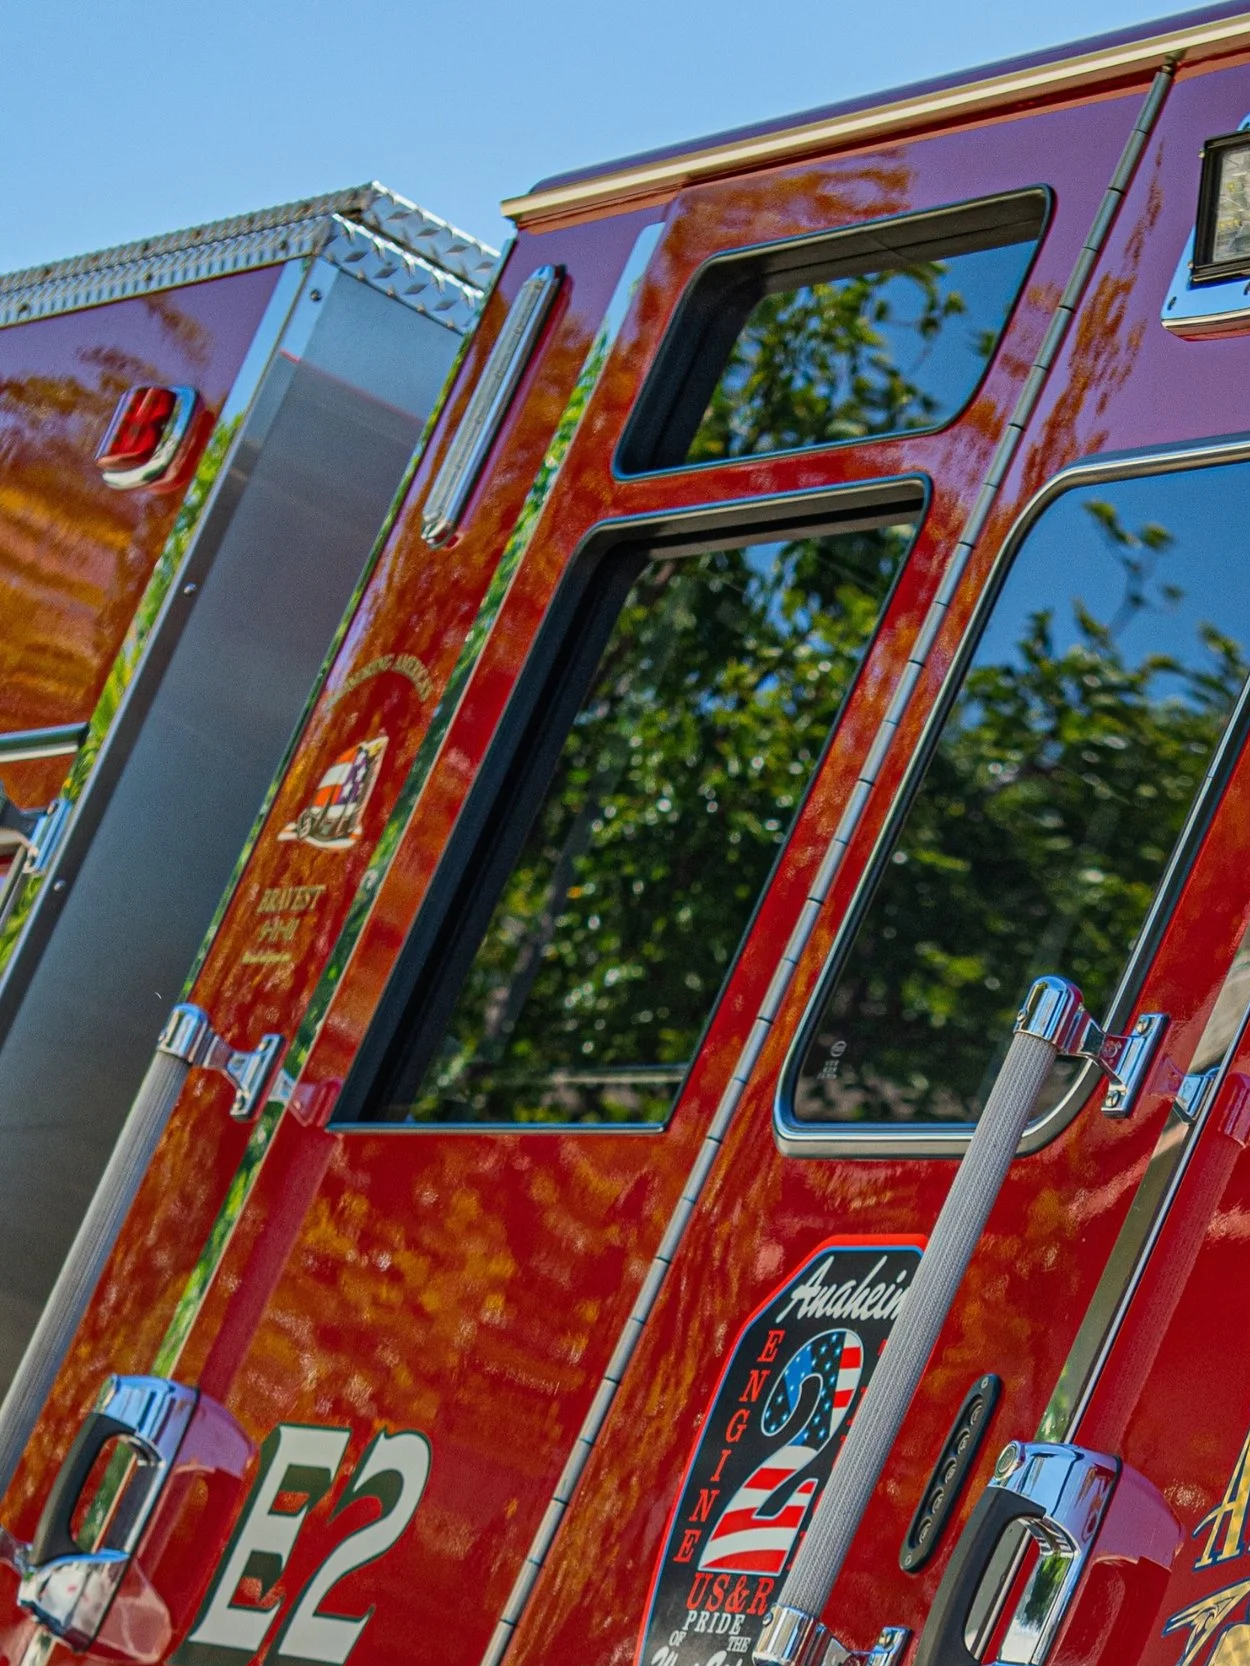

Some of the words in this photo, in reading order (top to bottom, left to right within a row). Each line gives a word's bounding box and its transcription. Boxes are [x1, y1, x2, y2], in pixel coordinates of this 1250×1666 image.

[673, 1330, 786, 1563] ENGINE
[698, 1328, 864, 1577] 2
[686, 1571, 775, 1616] US&R
[668, 1629, 687, 1647] OF
[726, 1636, 752, 1653] THE
[682, 1609, 746, 1636] PRIDE
